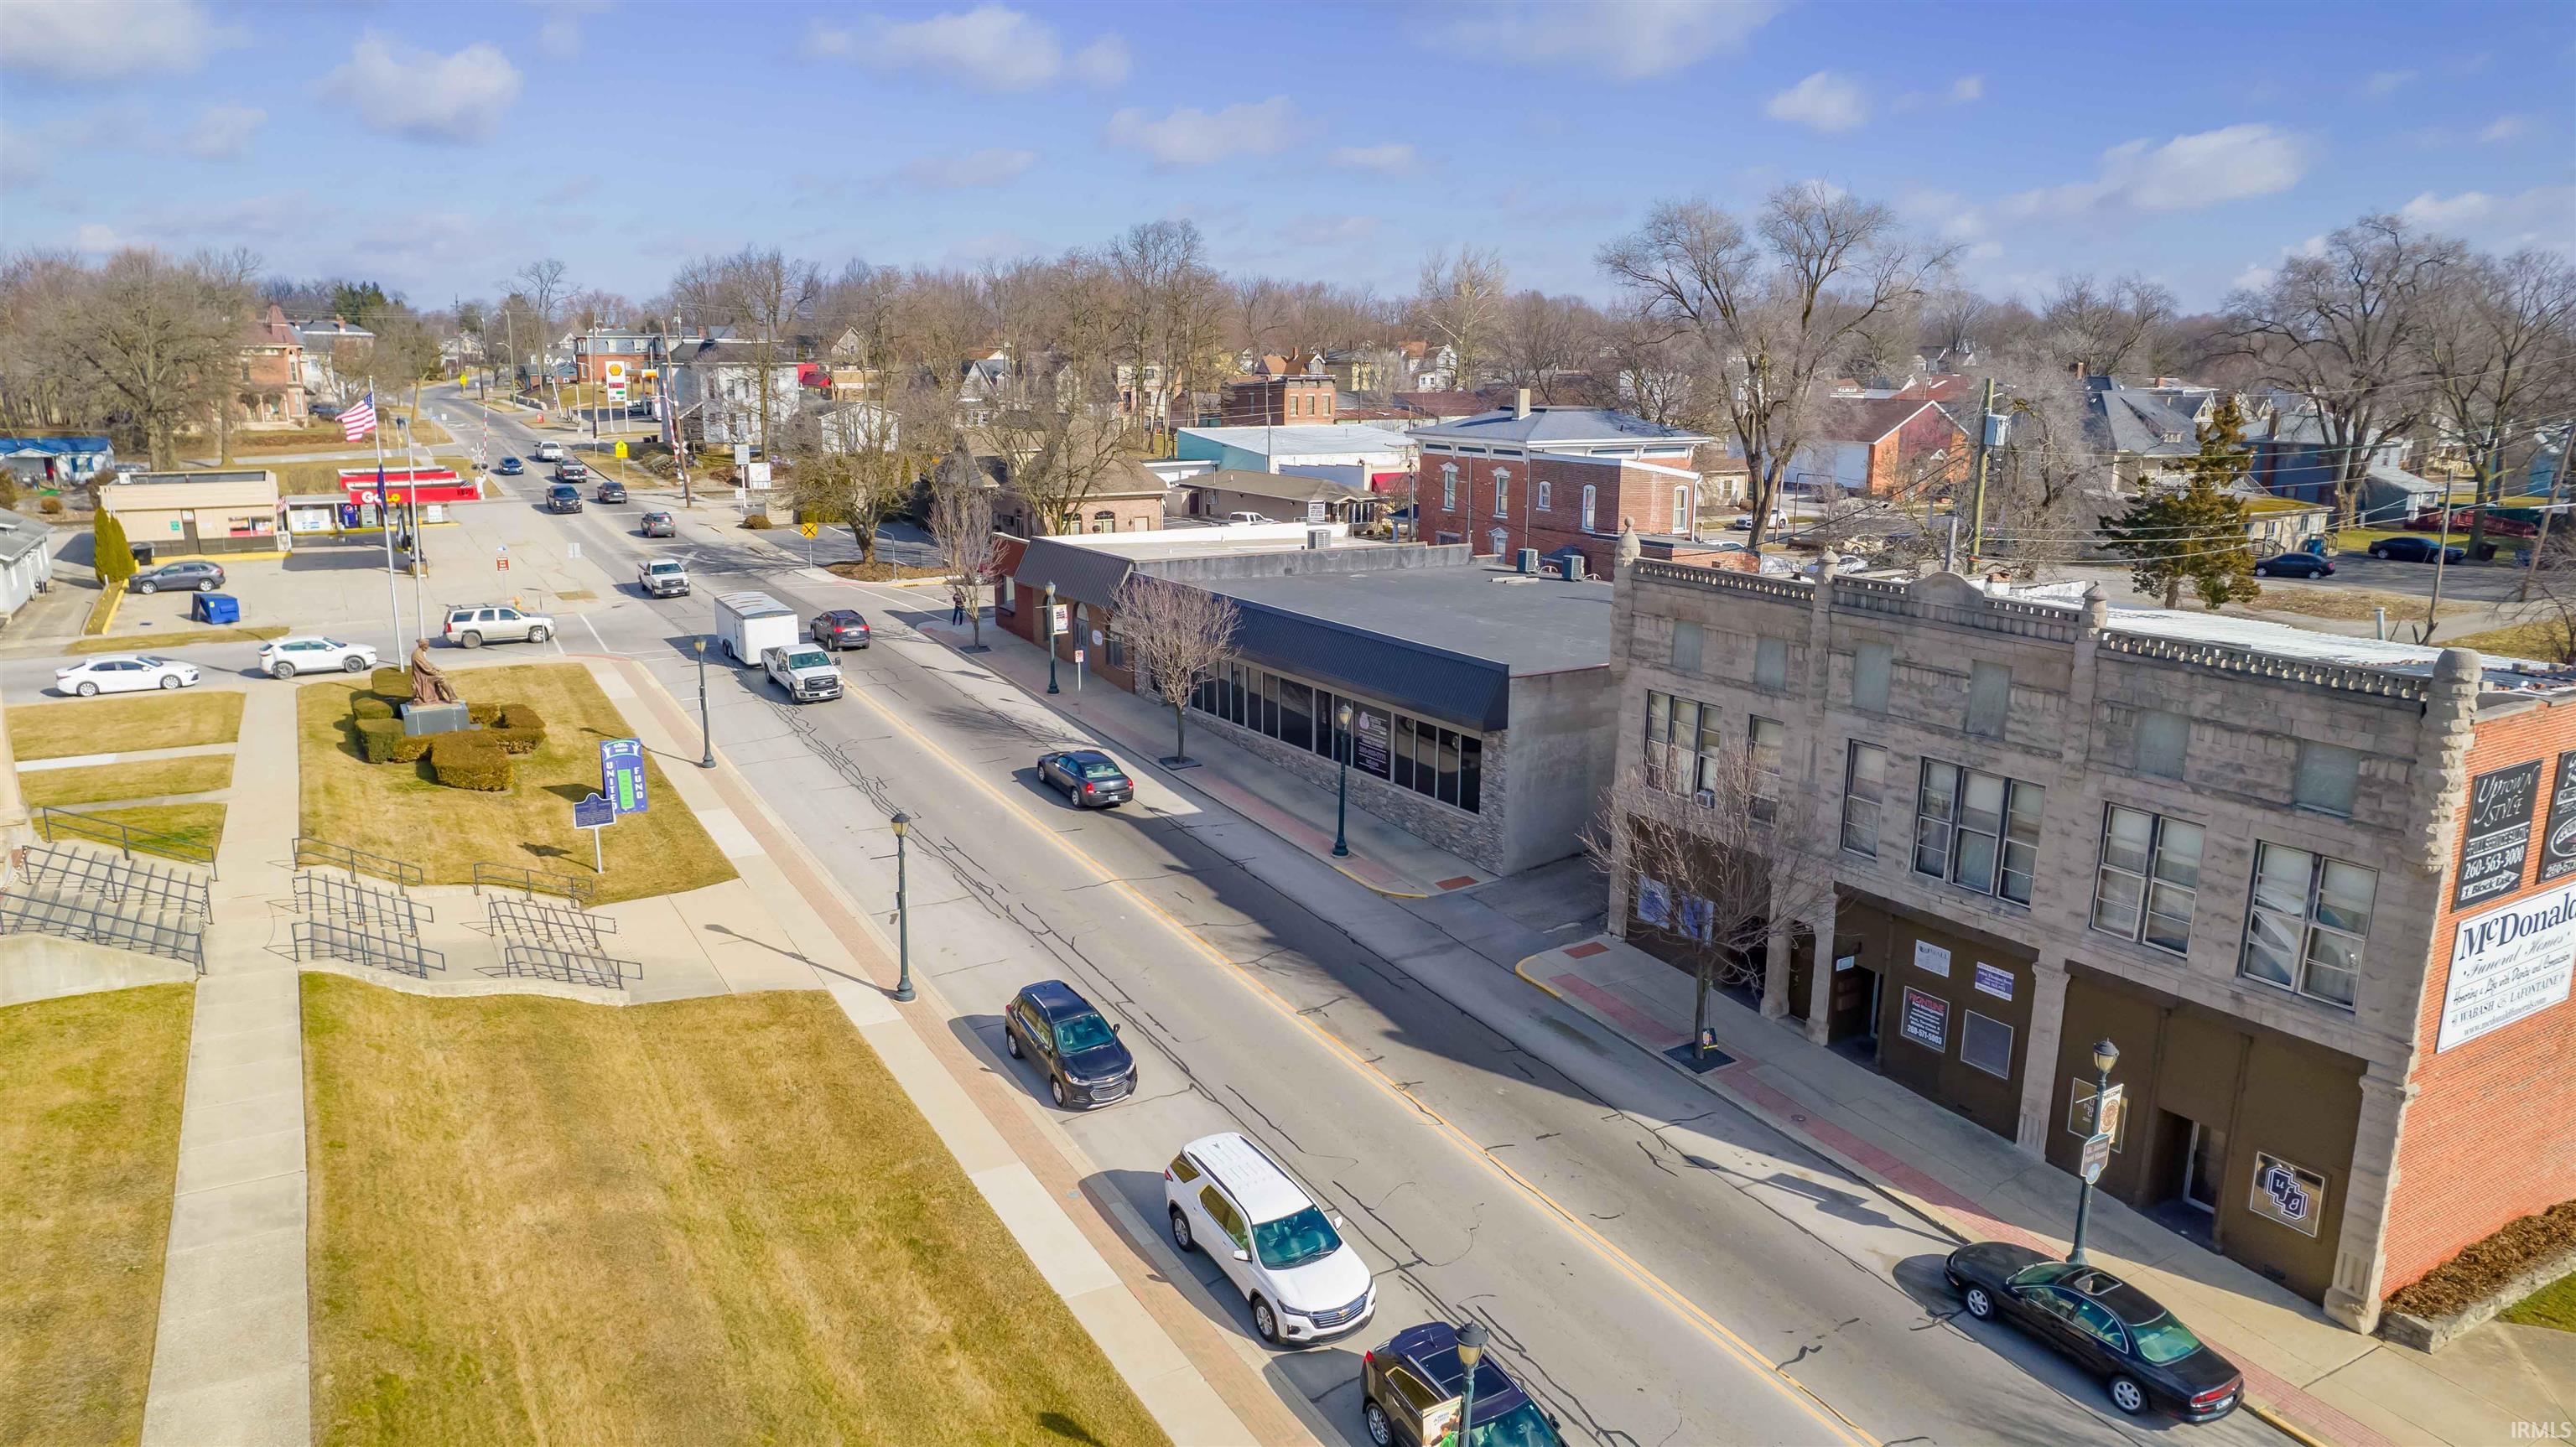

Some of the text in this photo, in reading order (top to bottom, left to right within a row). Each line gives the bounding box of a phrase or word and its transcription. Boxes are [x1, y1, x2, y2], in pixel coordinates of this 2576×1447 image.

[606, 761, 618, 810] UNITED
[634, 766, 643, 799] FUND
[2464, 845, 2525, 880] 260-563-3000
[2467, 933, 2564, 978] Funeral Homes
[2459, 999, 2495, 1023] WABASH
